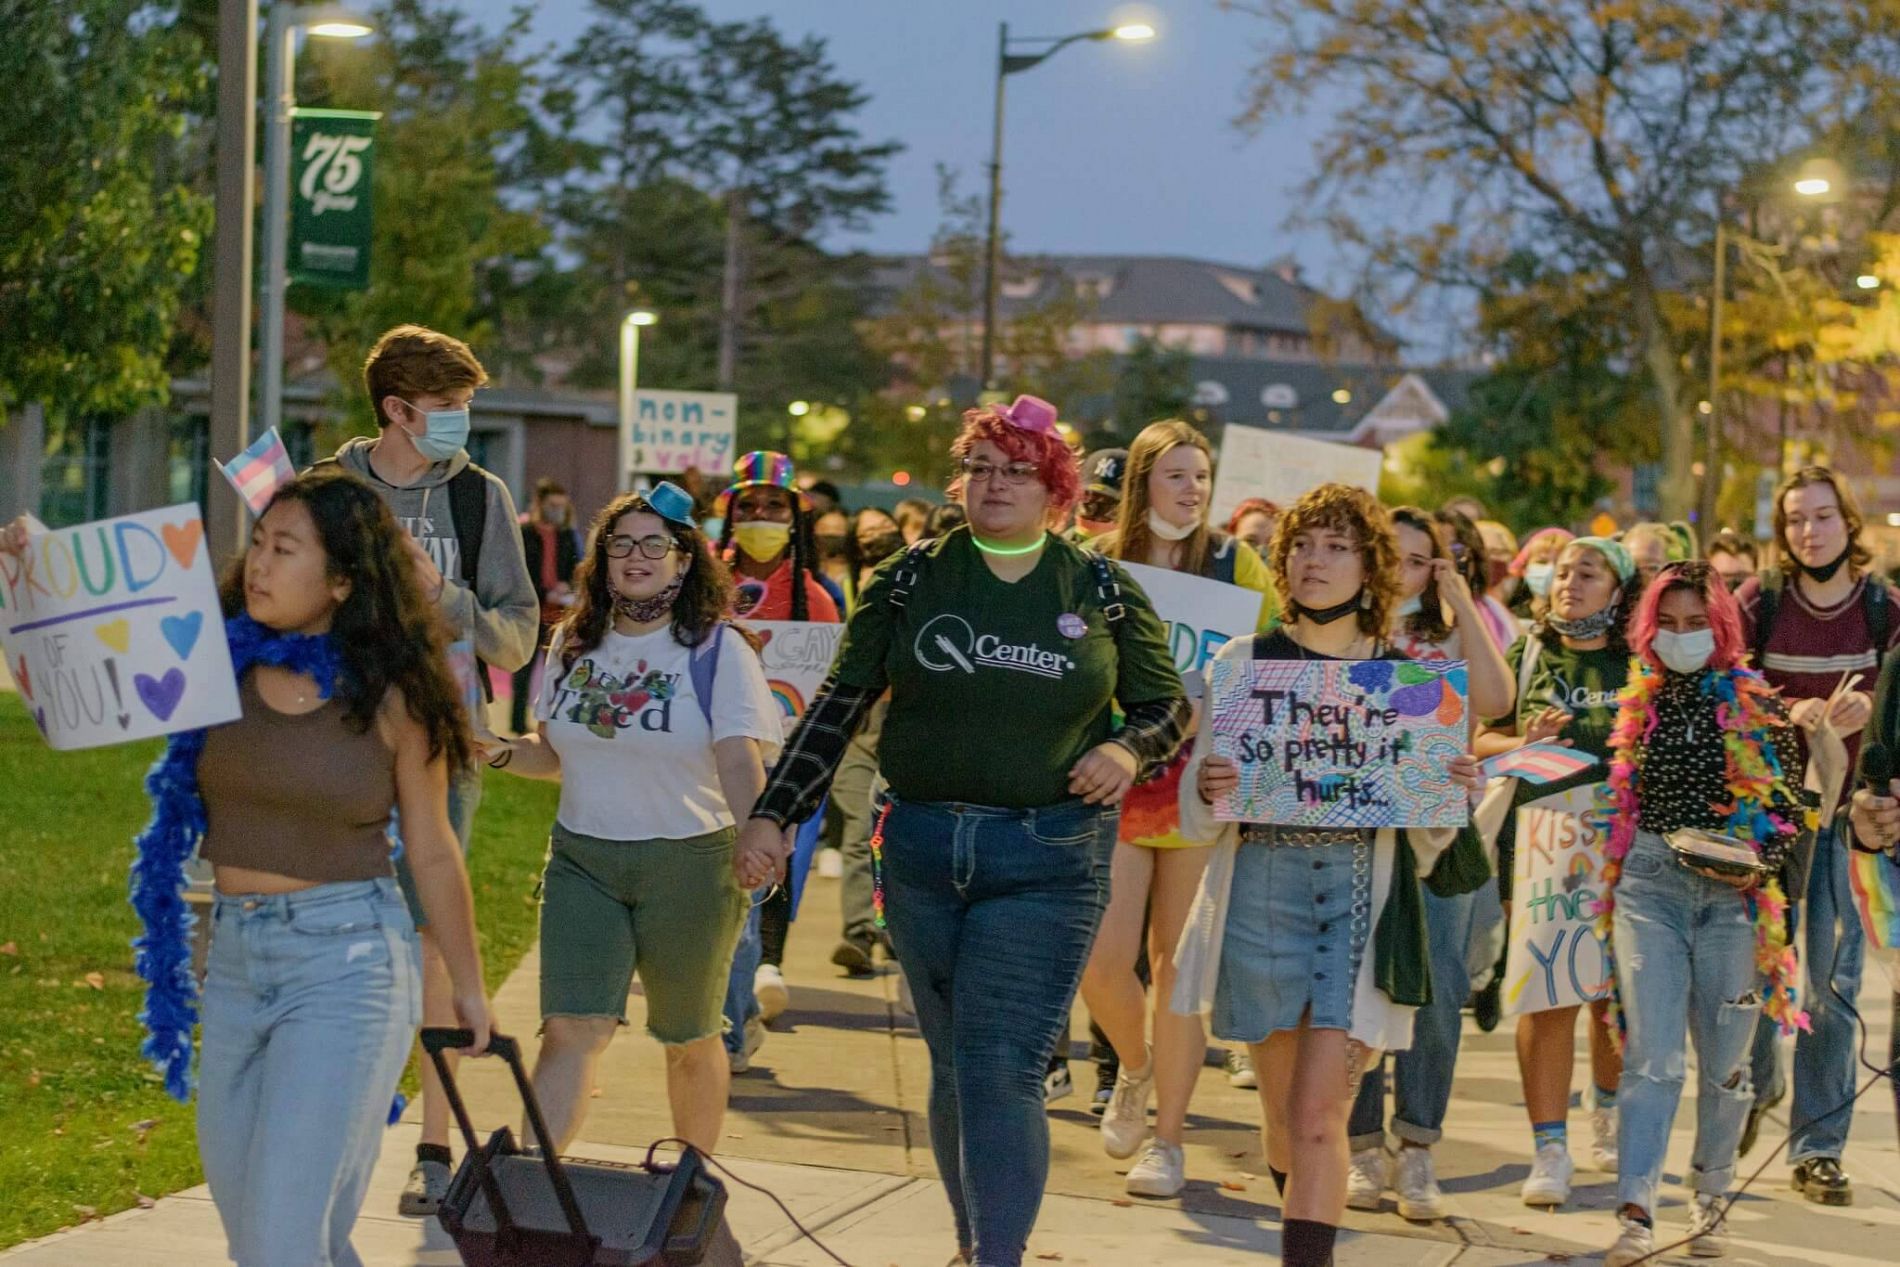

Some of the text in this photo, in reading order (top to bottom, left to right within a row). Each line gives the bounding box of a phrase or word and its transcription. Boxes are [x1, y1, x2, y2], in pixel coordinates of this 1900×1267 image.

[300, 132, 373, 200] 75
[633, 423, 731, 453] binary
[1251, 689, 1398, 737] They're
[1284, 732, 1366, 773] pretty
[1379, 735, 1400, 766] it
[1527, 877, 1602, 924] the
